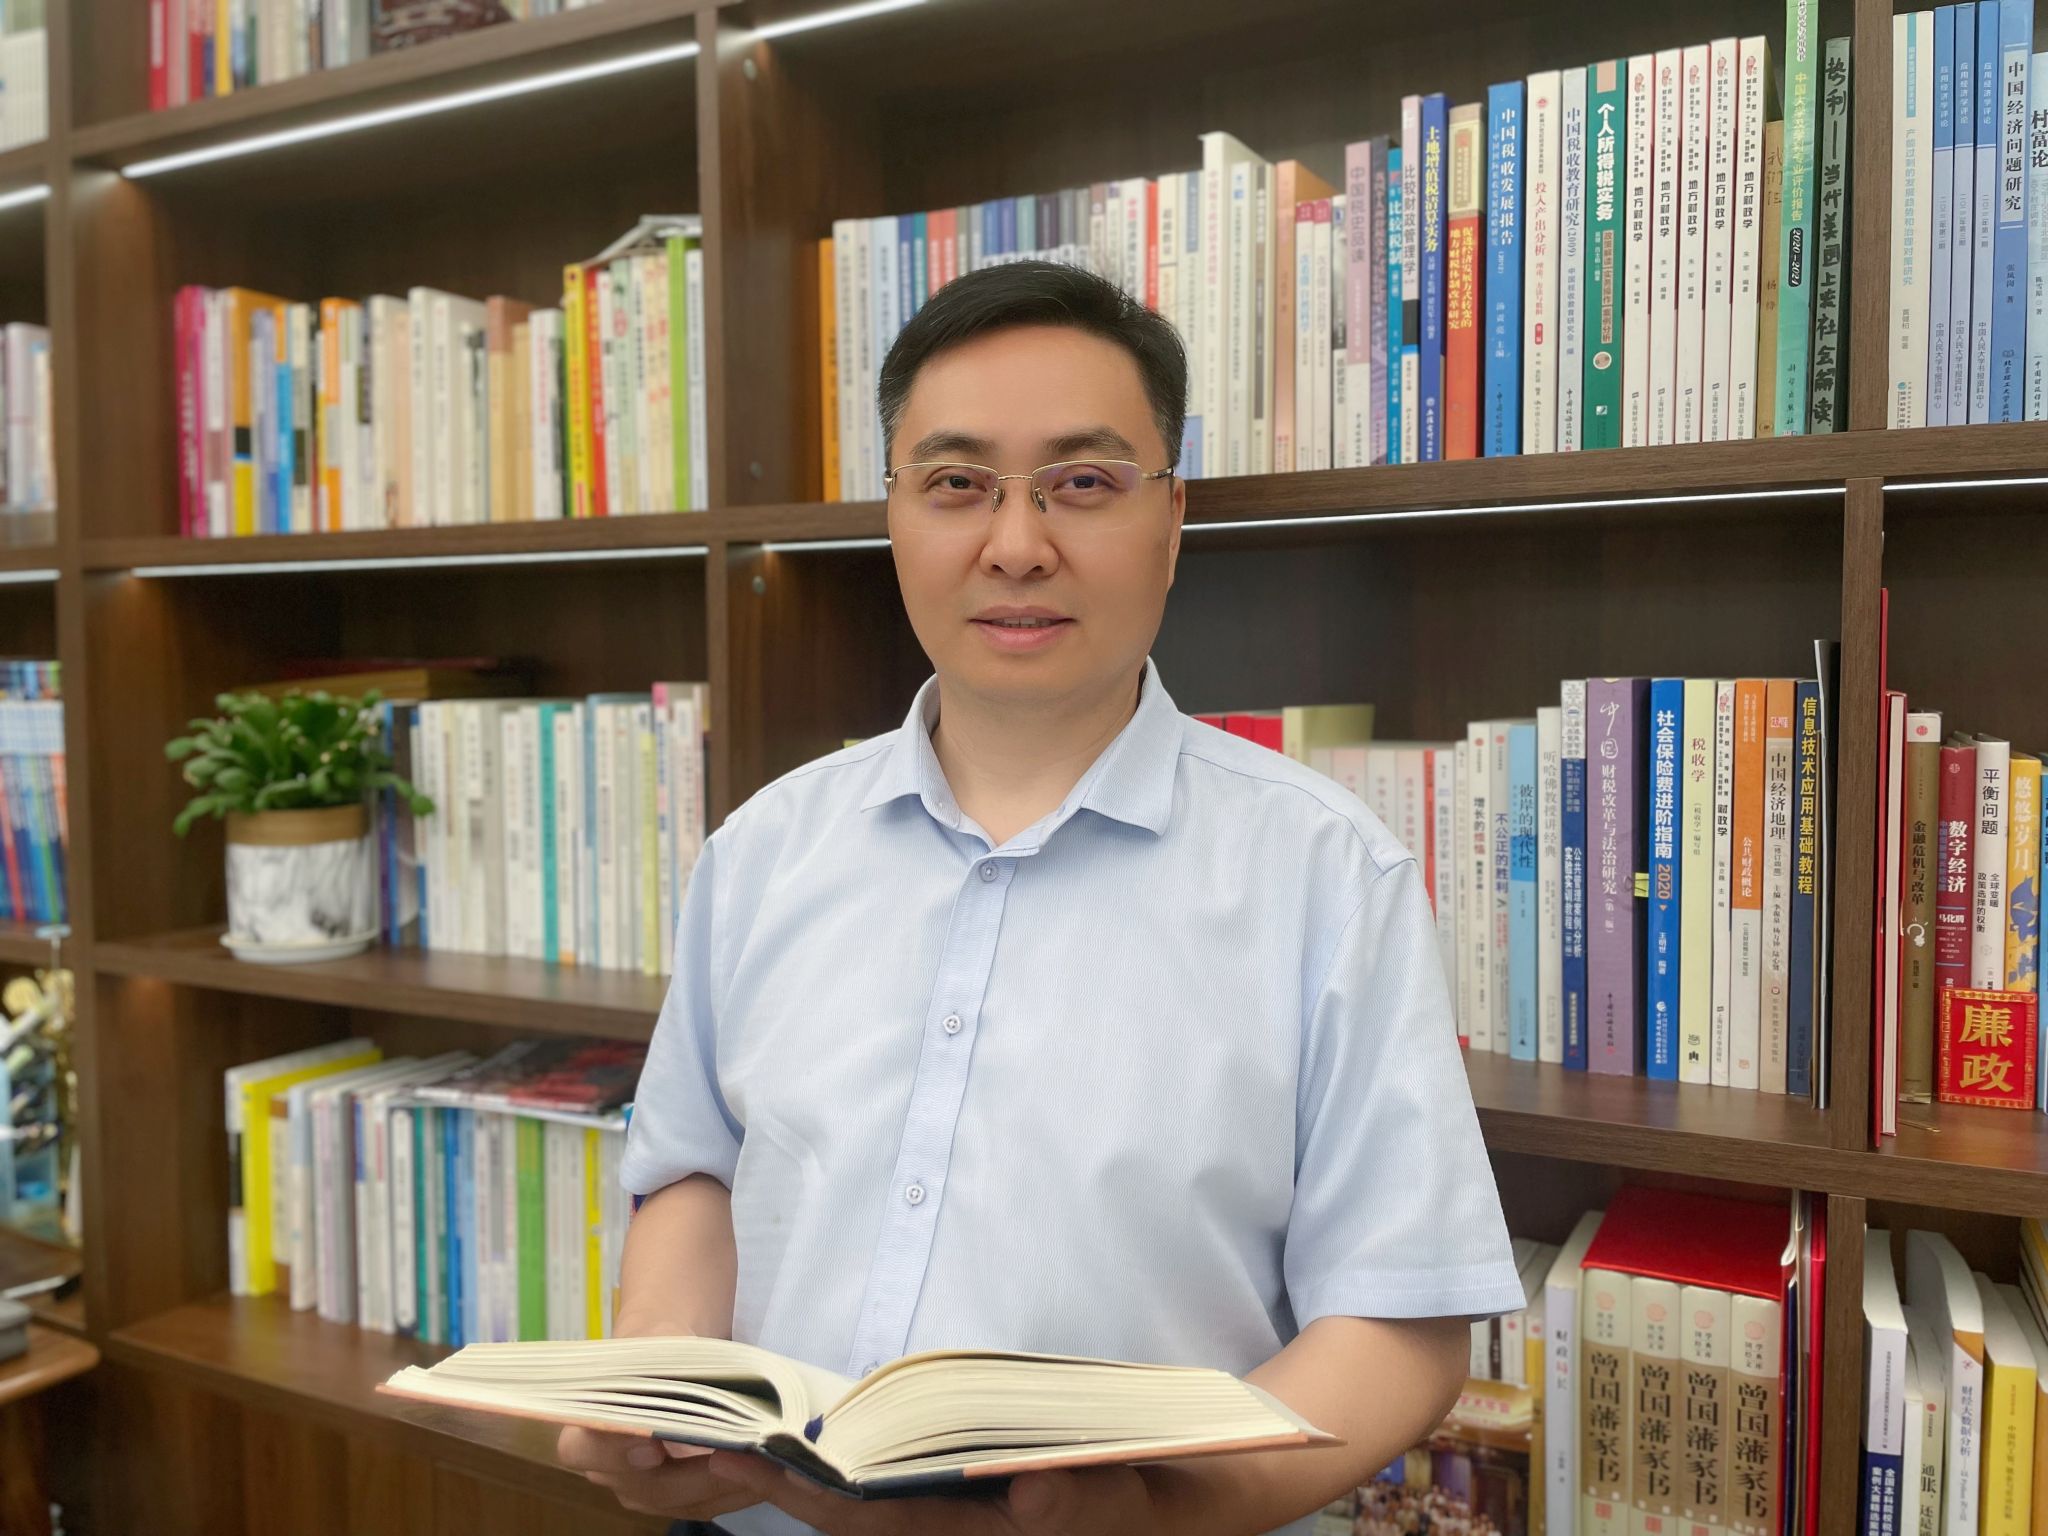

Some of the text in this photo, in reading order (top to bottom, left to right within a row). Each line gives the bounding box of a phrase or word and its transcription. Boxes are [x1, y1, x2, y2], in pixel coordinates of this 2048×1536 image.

[1939, 66, 1949, 127] 应用经济学评论
[1960, 62, 1969, 124] 应用经济学评论
[1983, 62, 1992, 125] 应用经济学评论
[1500, 108, 1516, 245] 中国税收发展报告
[1596, 103, 1615, 221] 个人所得税实务
[2005, 61, 2024, 211] 中国经济问题研究
[2031, 110, 2048, 168] 村富论
[1403, 165, 1417, 275] 比较财政管理学
[1425, 126, 1441, 252] 土地增值税清算实务
[1535, 182, 1547, 256] 投入产出分析
[1633, 186, 1644, 243] 地方财政学
[1660, 181, 1671, 237] 地方财政学
[1687, 179, 1699, 236] 地方财政学
[1715, 172, 1727, 229] 地方财政学
[1743, 171, 1755, 229] 地方财政学
[1934, 322, 1945, 409] 中国人民大学书报资料中心
[1954, 320, 1965, 406] 中国人民大学书报资料中心
[1976, 322, 1987, 408] 中国人民大学书报资料中心
[1691, 738, 1706, 783] 税收学
[1770, 752, 1787, 840] 中国经济地理
[1797, 697, 1817, 895] 信息技术应用基础教程
[1981, 768, 2000, 835] 平衡问题
[1519, 785, 1533, 868] 彼岸的现代性
[1543, 751, 1557, 858] 听哈佛教授讲经典
[1655, 710, 1675, 899] 社会保险费进阶指南 2020
[1717, 804, 1728, 837] 财政学
[2014, 776, 2032, 871] 悠悠岁月
[1495, 812, 1509, 894] 不公正的胜利
[1741, 836, 1753, 898] 公共财政概论
[1911, 820, 1927, 905] 金融危机与改革
[1947, 820, 1968, 893] 数字经济
[1989, 873, 2000, 908] 全球变暖
[1573, 847, 1582, 958] 公共管理案例分析
[1939, 914, 1965, 924] 马化腾
[1976, 872, 1987, 933] 政策选择的权衡
[1958, 1003, 2014, 1094] 廉政
[1589, 1351, 1621, 1483] 曾国藩家书
[1639, 1364, 1672, 1496] 曾国藩家书
[1686, 1371, 1719, 1506] 曾国藩家书
[1736, 1382, 1770, 1519] 曾国藩家书
[1960, 1386, 1973, 1457] 财经大数据分析
